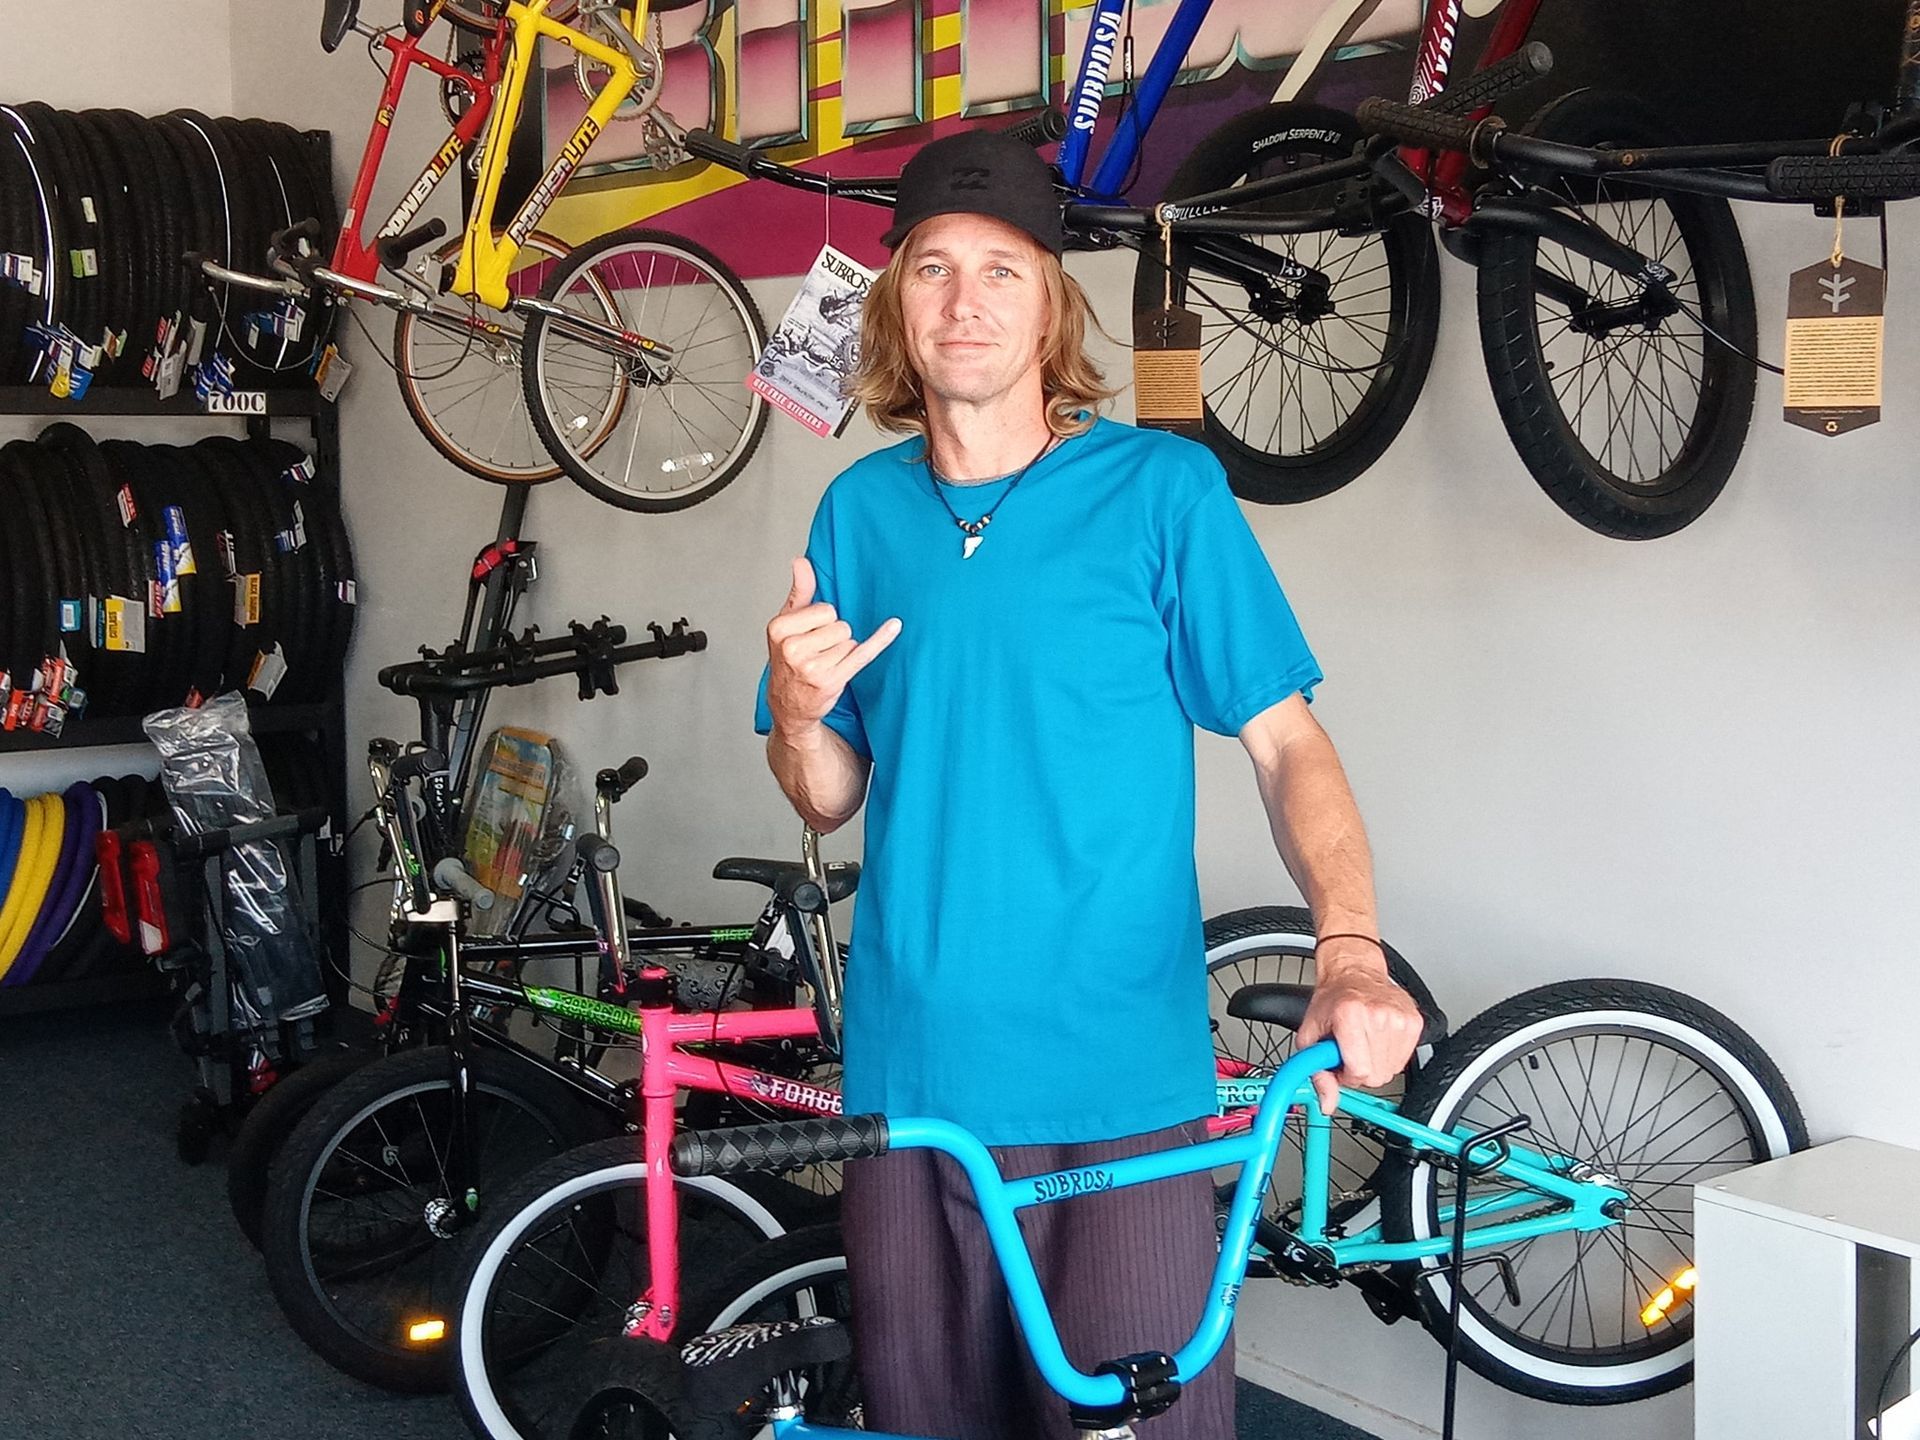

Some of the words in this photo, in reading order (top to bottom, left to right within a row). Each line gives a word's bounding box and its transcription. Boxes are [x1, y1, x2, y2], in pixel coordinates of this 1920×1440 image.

[1073, 11, 1122, 135] SUBROSA
[1252, 131, 1288, 152] SHADOW
[1288, 128, 1327, 140] SERPENT
[508, 117, 600, 246] POWERLITE
[821, 251, 873, 298] SUBROS
[210, 393, 264, 412] 700C
[767, 388, 788, 405] FREE
[786, 400, 824, 429] STICKERS
[1034, 1170, 1114, 1202] SUBROSA
